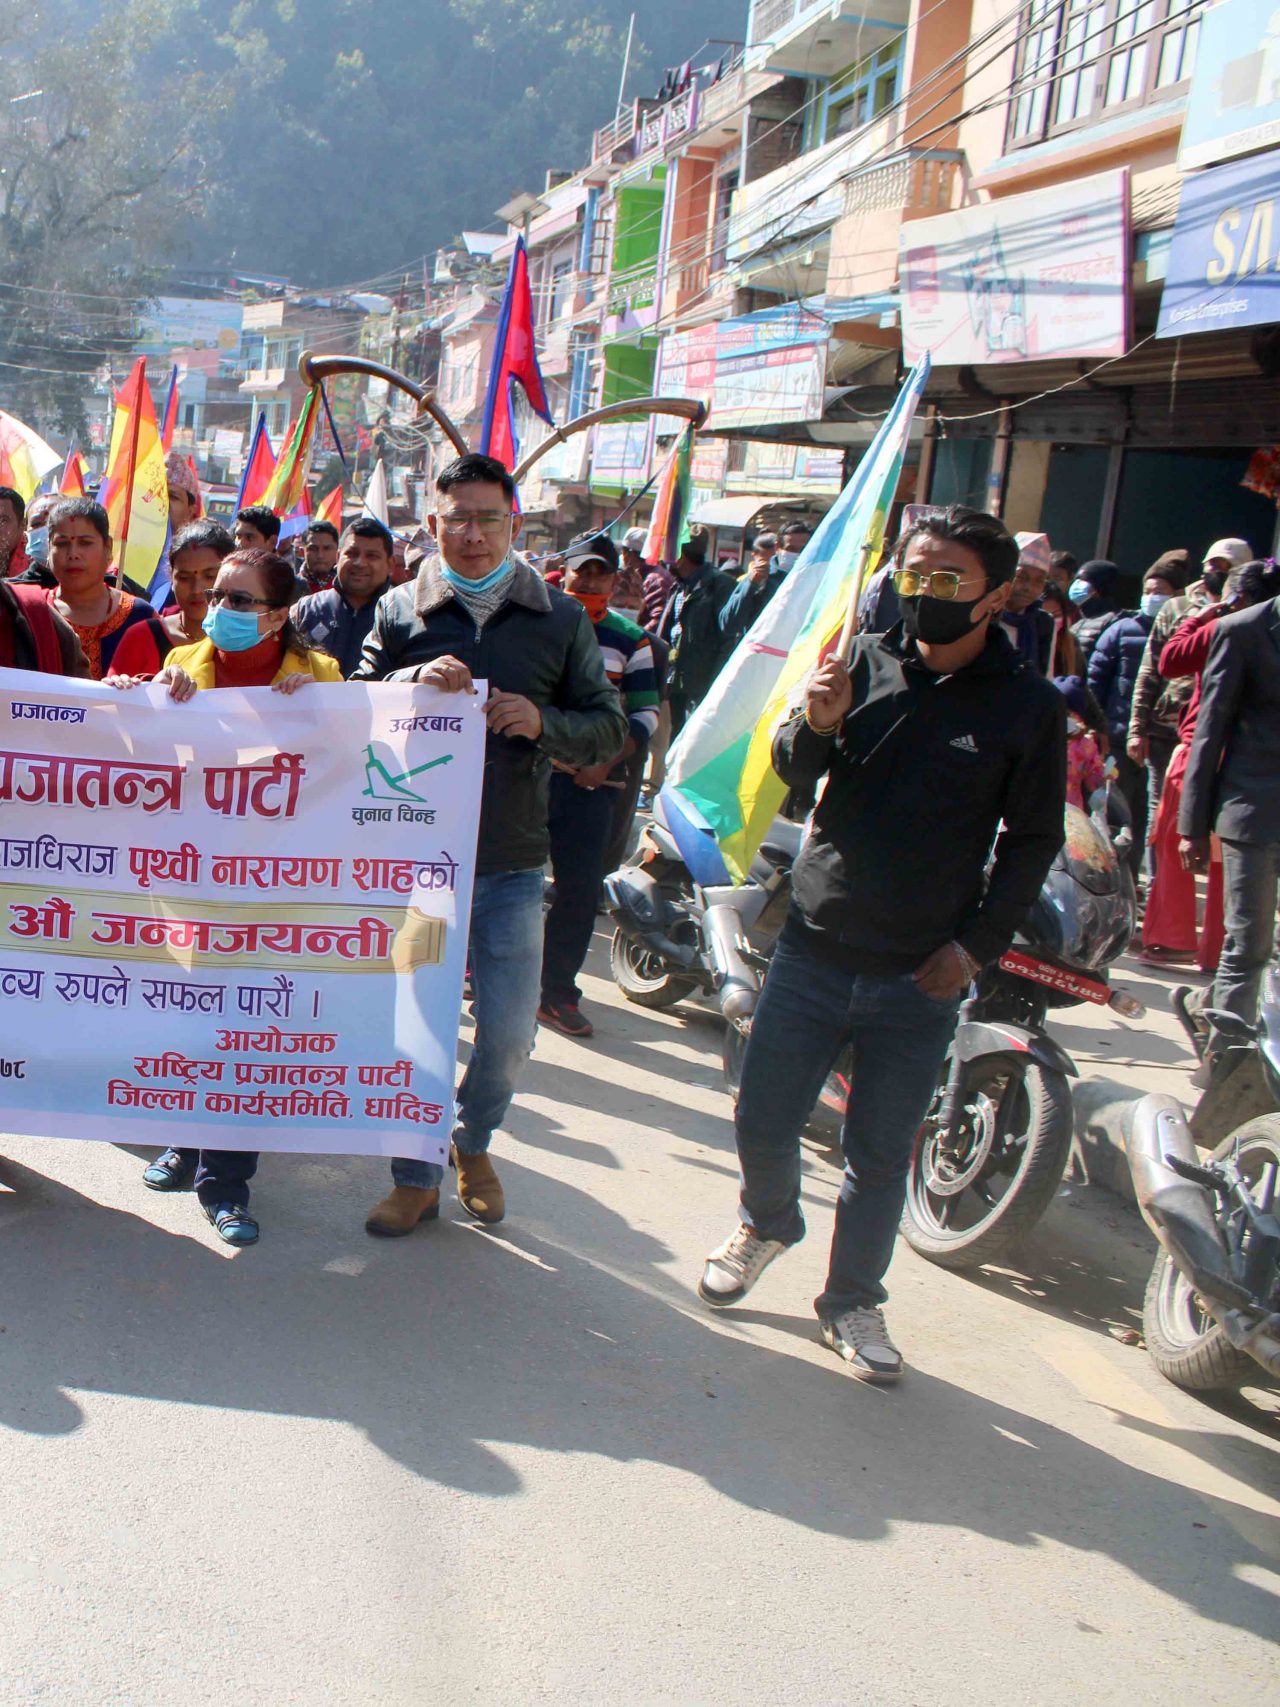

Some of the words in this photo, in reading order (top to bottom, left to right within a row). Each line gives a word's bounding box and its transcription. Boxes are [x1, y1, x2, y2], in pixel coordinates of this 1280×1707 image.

[1207, 199, 1280, 286] SA
[11, 702, 87, 723] प्रजातन्त्र
[389, 716, 463, 734] उदारबाद
[204, 752, 306, 817] पार्टी
[352, 807, 392, 825] चुनाव
[397, 804, 437, 825] चिन्ह
[129, 843, 201, 887] पृथ्वी
[211, 857, 343, 887] नारायण
[352, 851, 460, 893] शाहको
[91, 912, 394, 959] जन्मजयन्ती
[55, 965, 131, 1006] रुपले
[141, 979, 226, 1014] सफल
[237, 974, 295, 1018] पारौं
[216, 1026, 338, 1054] आयोजक
[134, 1052, 226, 1085] राष्ट्रिय
[233, 1063, 348, 1088] प्रजातन्त्र
[358, 1061, 414, 1088] पार्टी
[107, 1079, 197, 1111] जिल्ला
[364, 1092, 444, 1125] धादिङ
